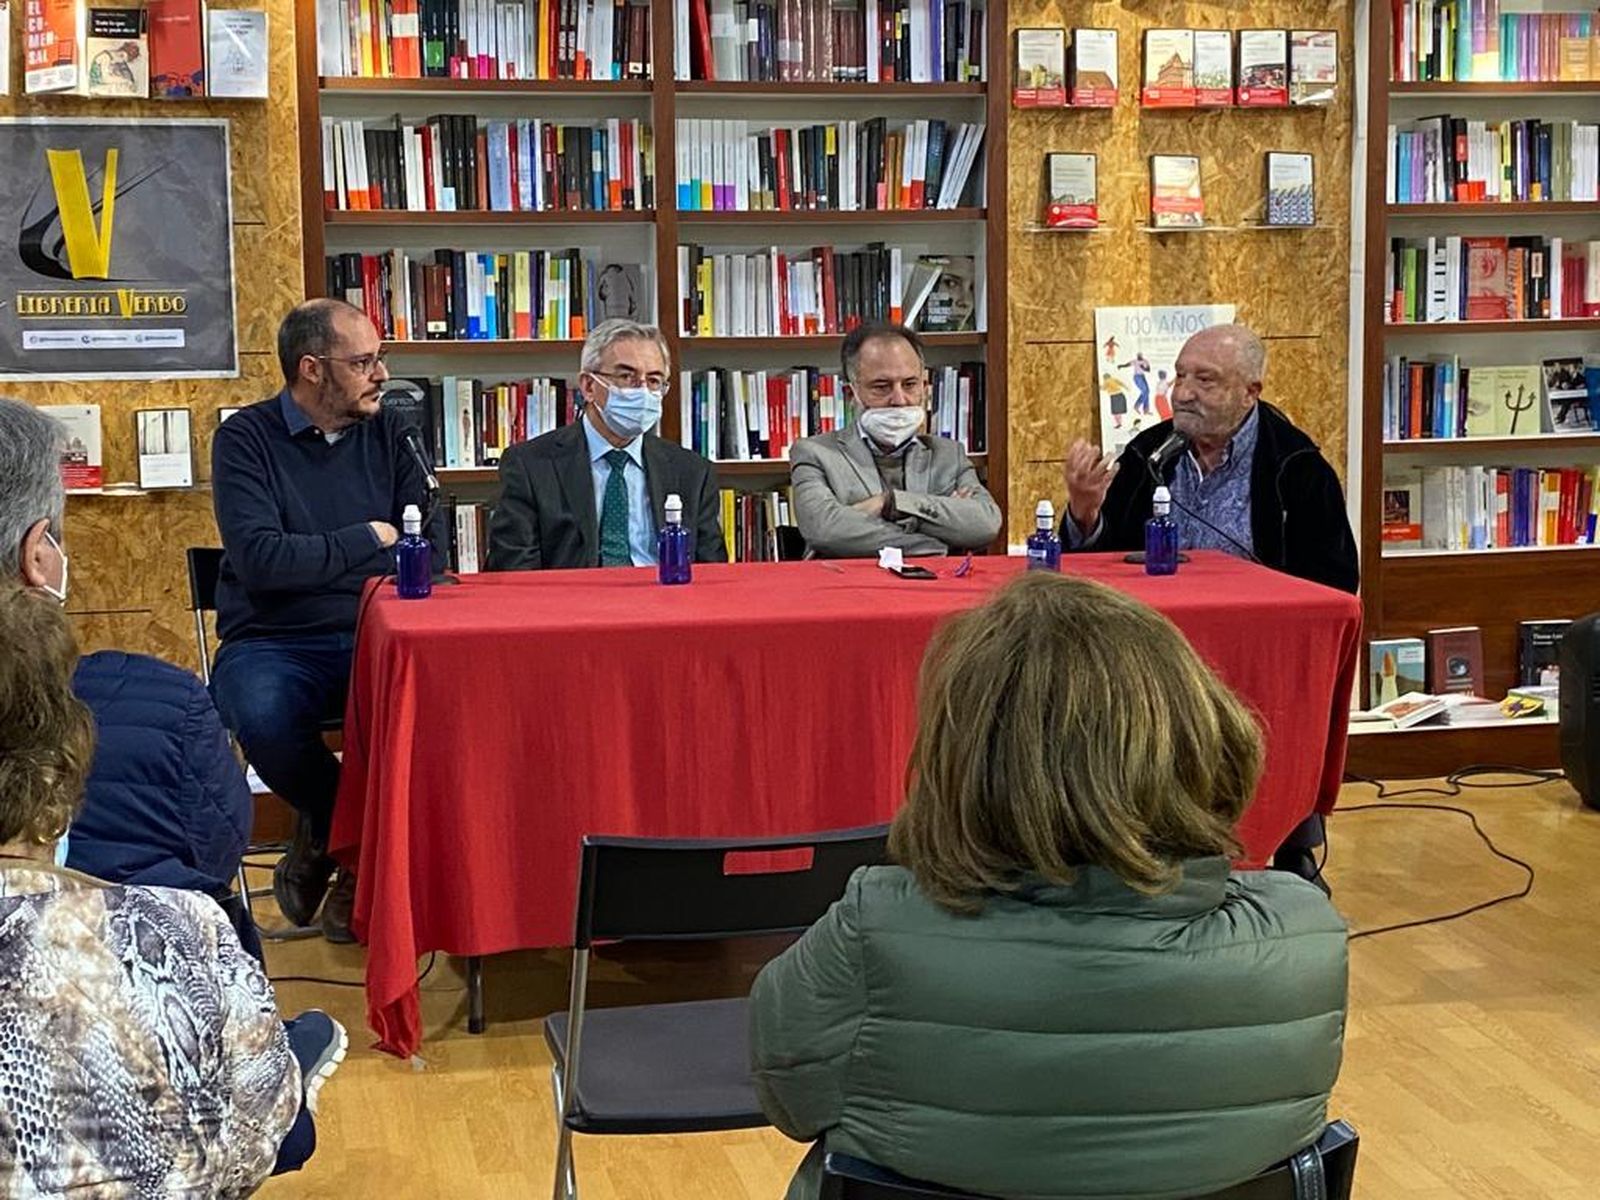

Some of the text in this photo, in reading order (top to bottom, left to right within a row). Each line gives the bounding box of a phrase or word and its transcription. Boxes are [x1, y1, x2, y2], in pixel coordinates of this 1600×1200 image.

[16, 294, 111, 314] LIBRERIA
[1125, 311, 1206, 335] 100 AÑOS
